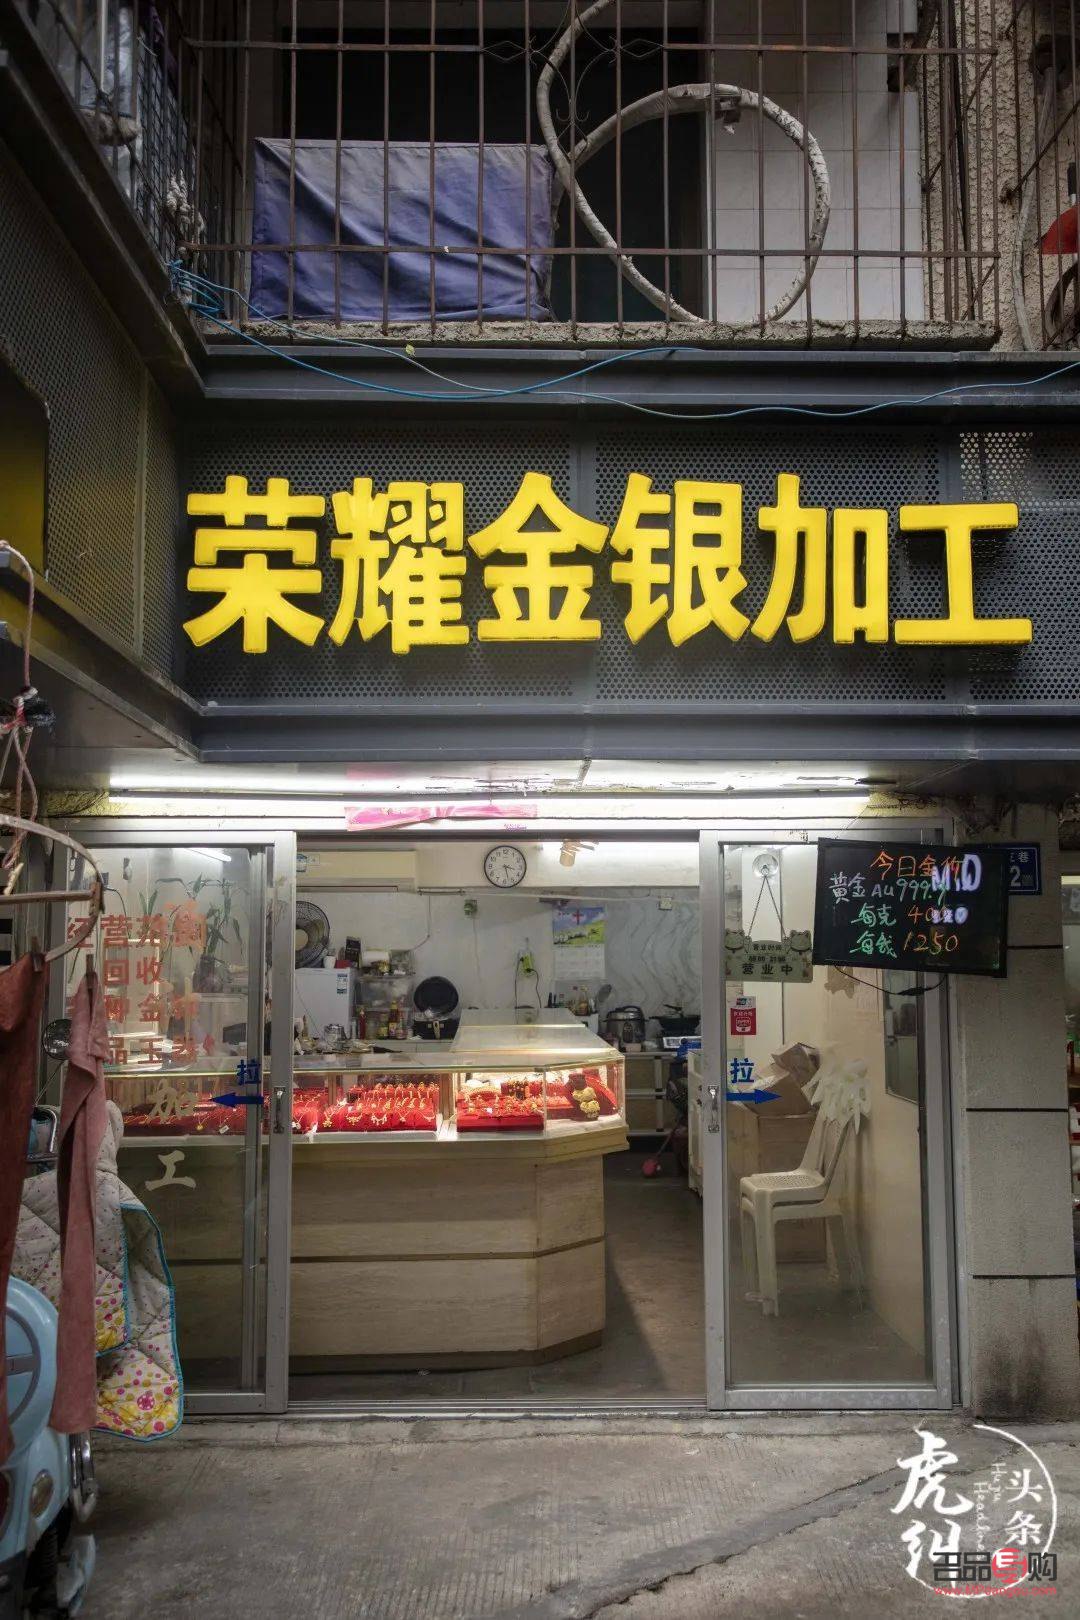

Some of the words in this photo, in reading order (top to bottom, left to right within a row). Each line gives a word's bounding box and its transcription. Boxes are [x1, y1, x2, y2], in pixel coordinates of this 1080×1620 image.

[183, 472, 1033, 655] 荣耀金银加工
[829, 873, 866, 904] 黄金
[851, 902, 897, 927] 每克
[903, 931, 959, 955] 1250
[103, 956, 163, 985] 回收
[742, 963, 793, 975] 营业中
[236, 1060, 262, 1086] 拉
[730, 1058, 755, 1084] 拉
